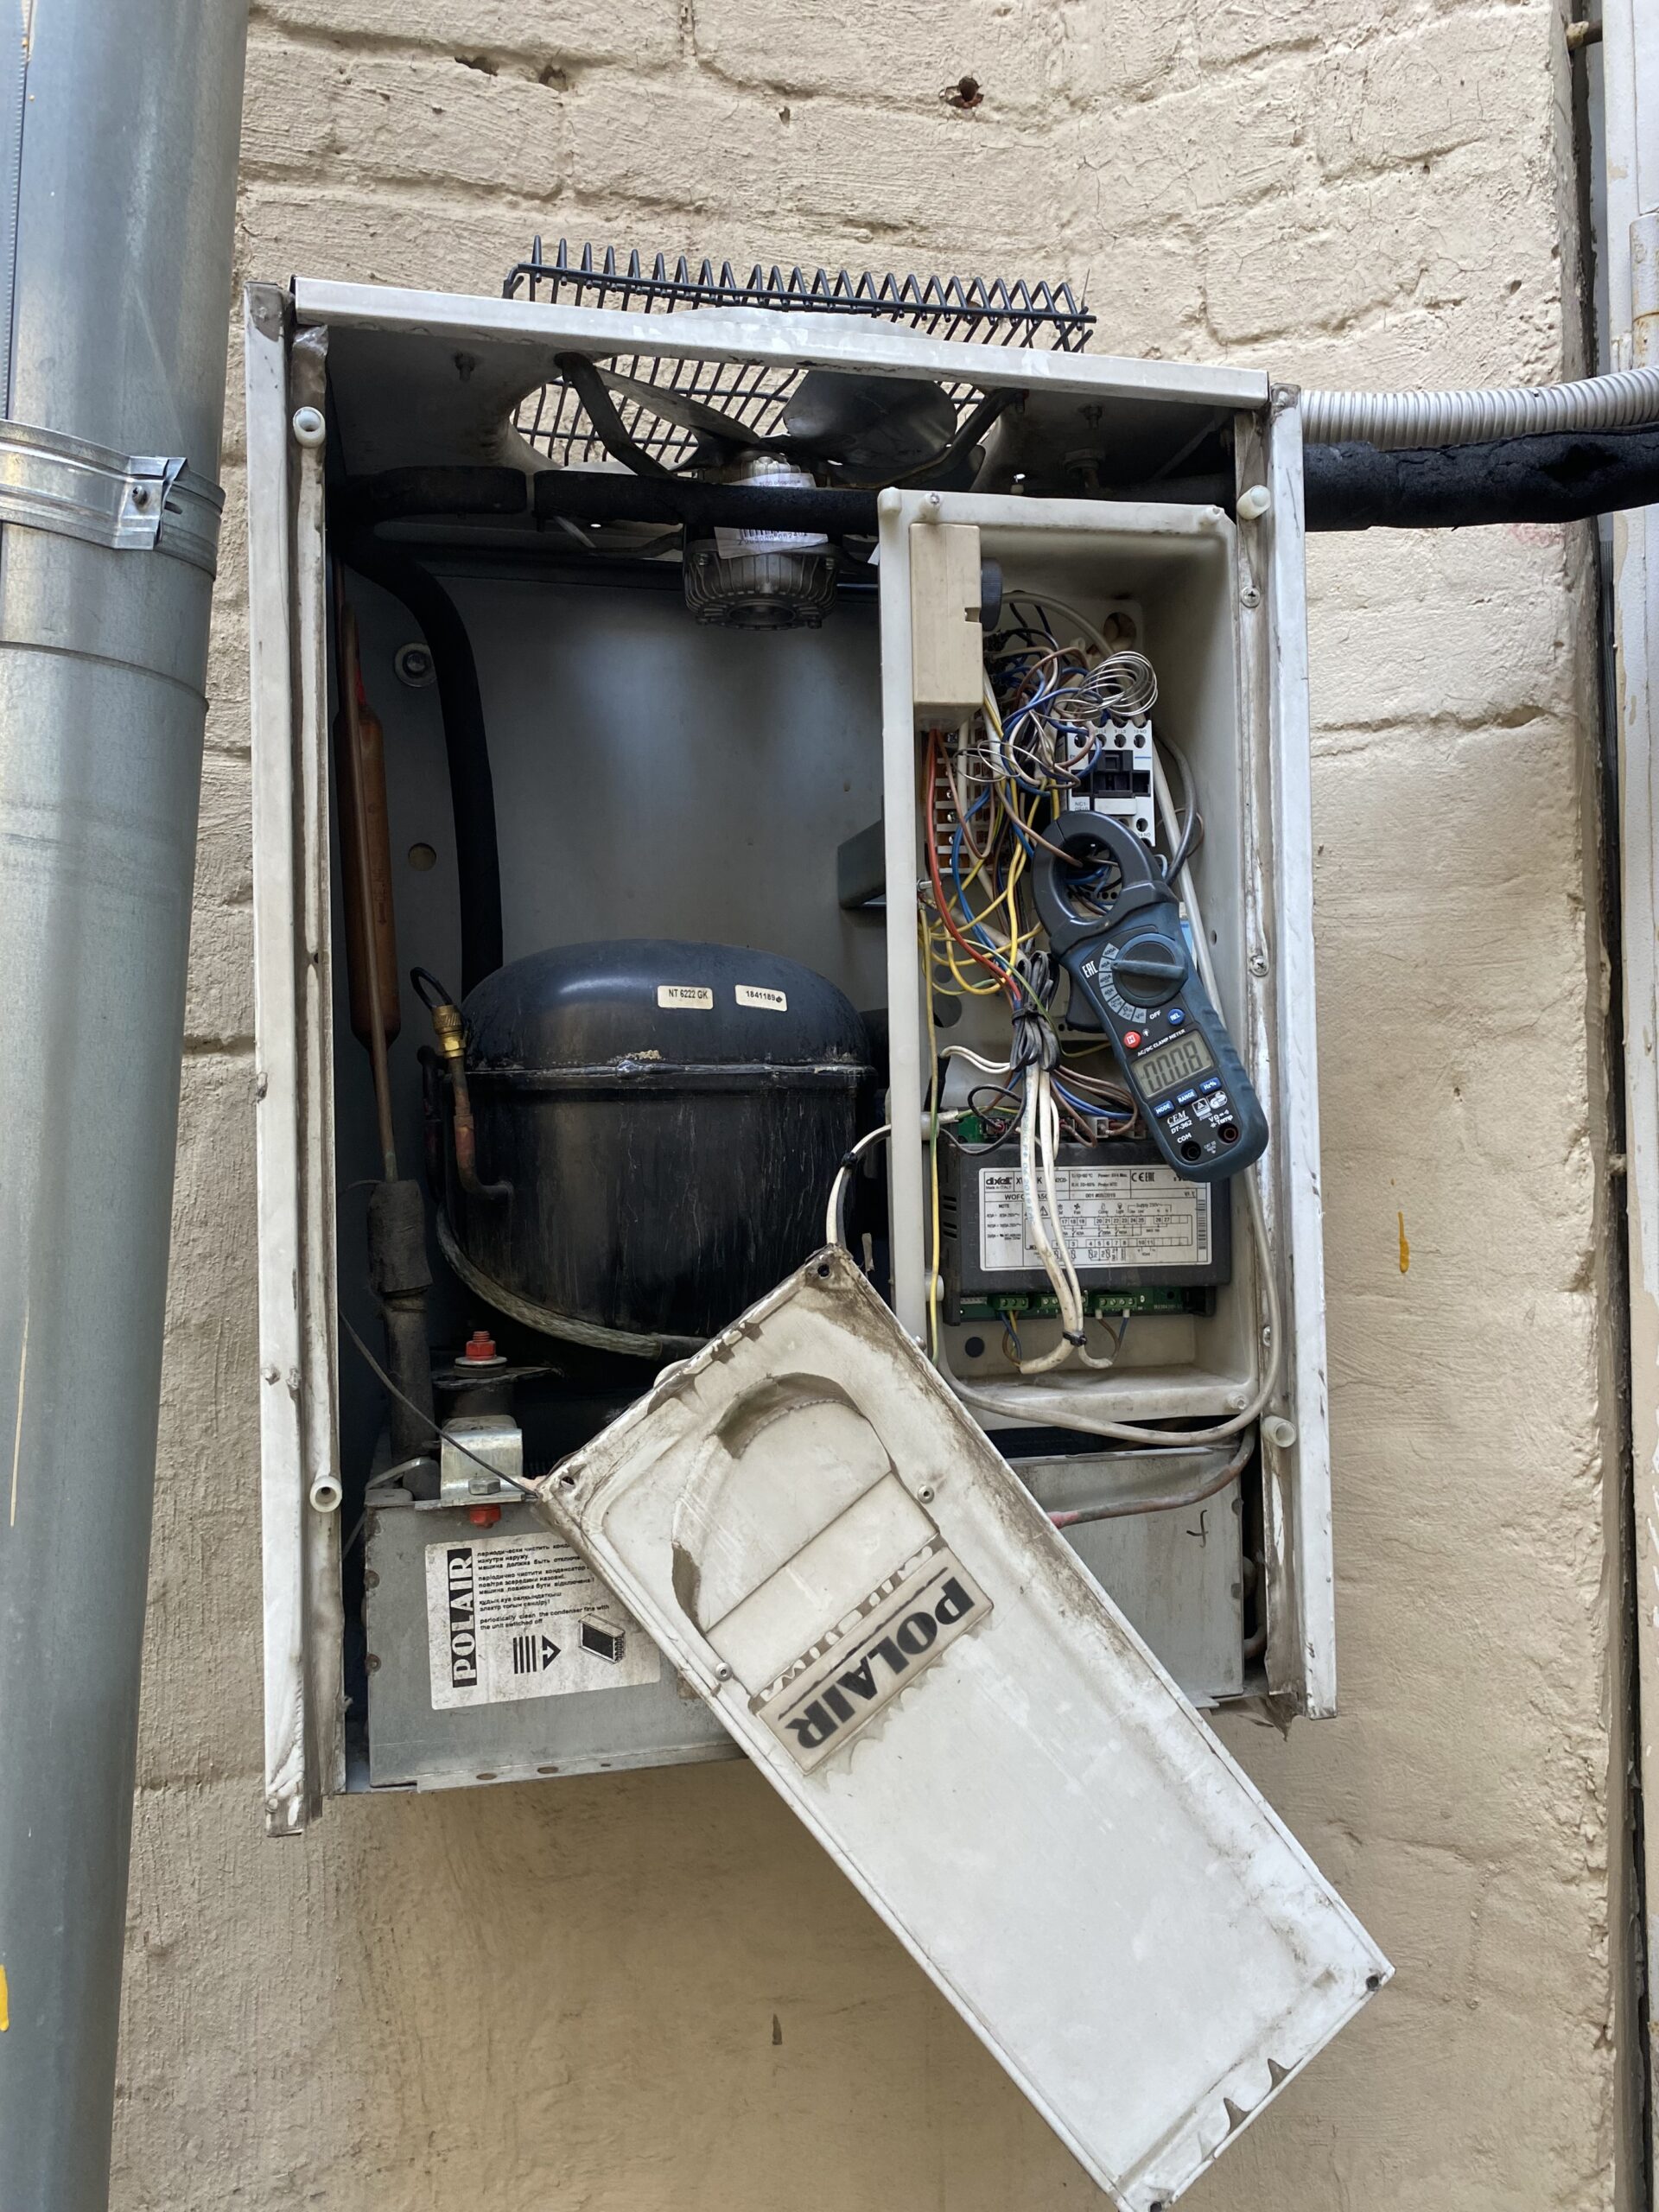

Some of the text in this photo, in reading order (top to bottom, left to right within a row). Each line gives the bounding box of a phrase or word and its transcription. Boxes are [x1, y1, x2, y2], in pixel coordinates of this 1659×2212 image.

[669, 988, 709, 1000] NT 6222 GK
[746, 990, 776, 1001] 1841189
[1149, 1009, 1161, 1020] OFF
[1137, 1028, 1186, 1057] AC/DC CLAMP METER
[1178, 1091, 1195, 1103] RANGE
[1155, 1103, 1171, 1115] MODE
[1166, 1109, 1187, 1125] CEM
[1171, 1120, 1193, 1135] DT-362
[1177, 1133, 1192, 1144] COM
[448, 1554, 477, 1682] POLAIR
[480, 1614, 516, 1624] periodically
[550, 1607, 582, 1616] condenser
[785, 1576, 976, 1749] POLAIR
